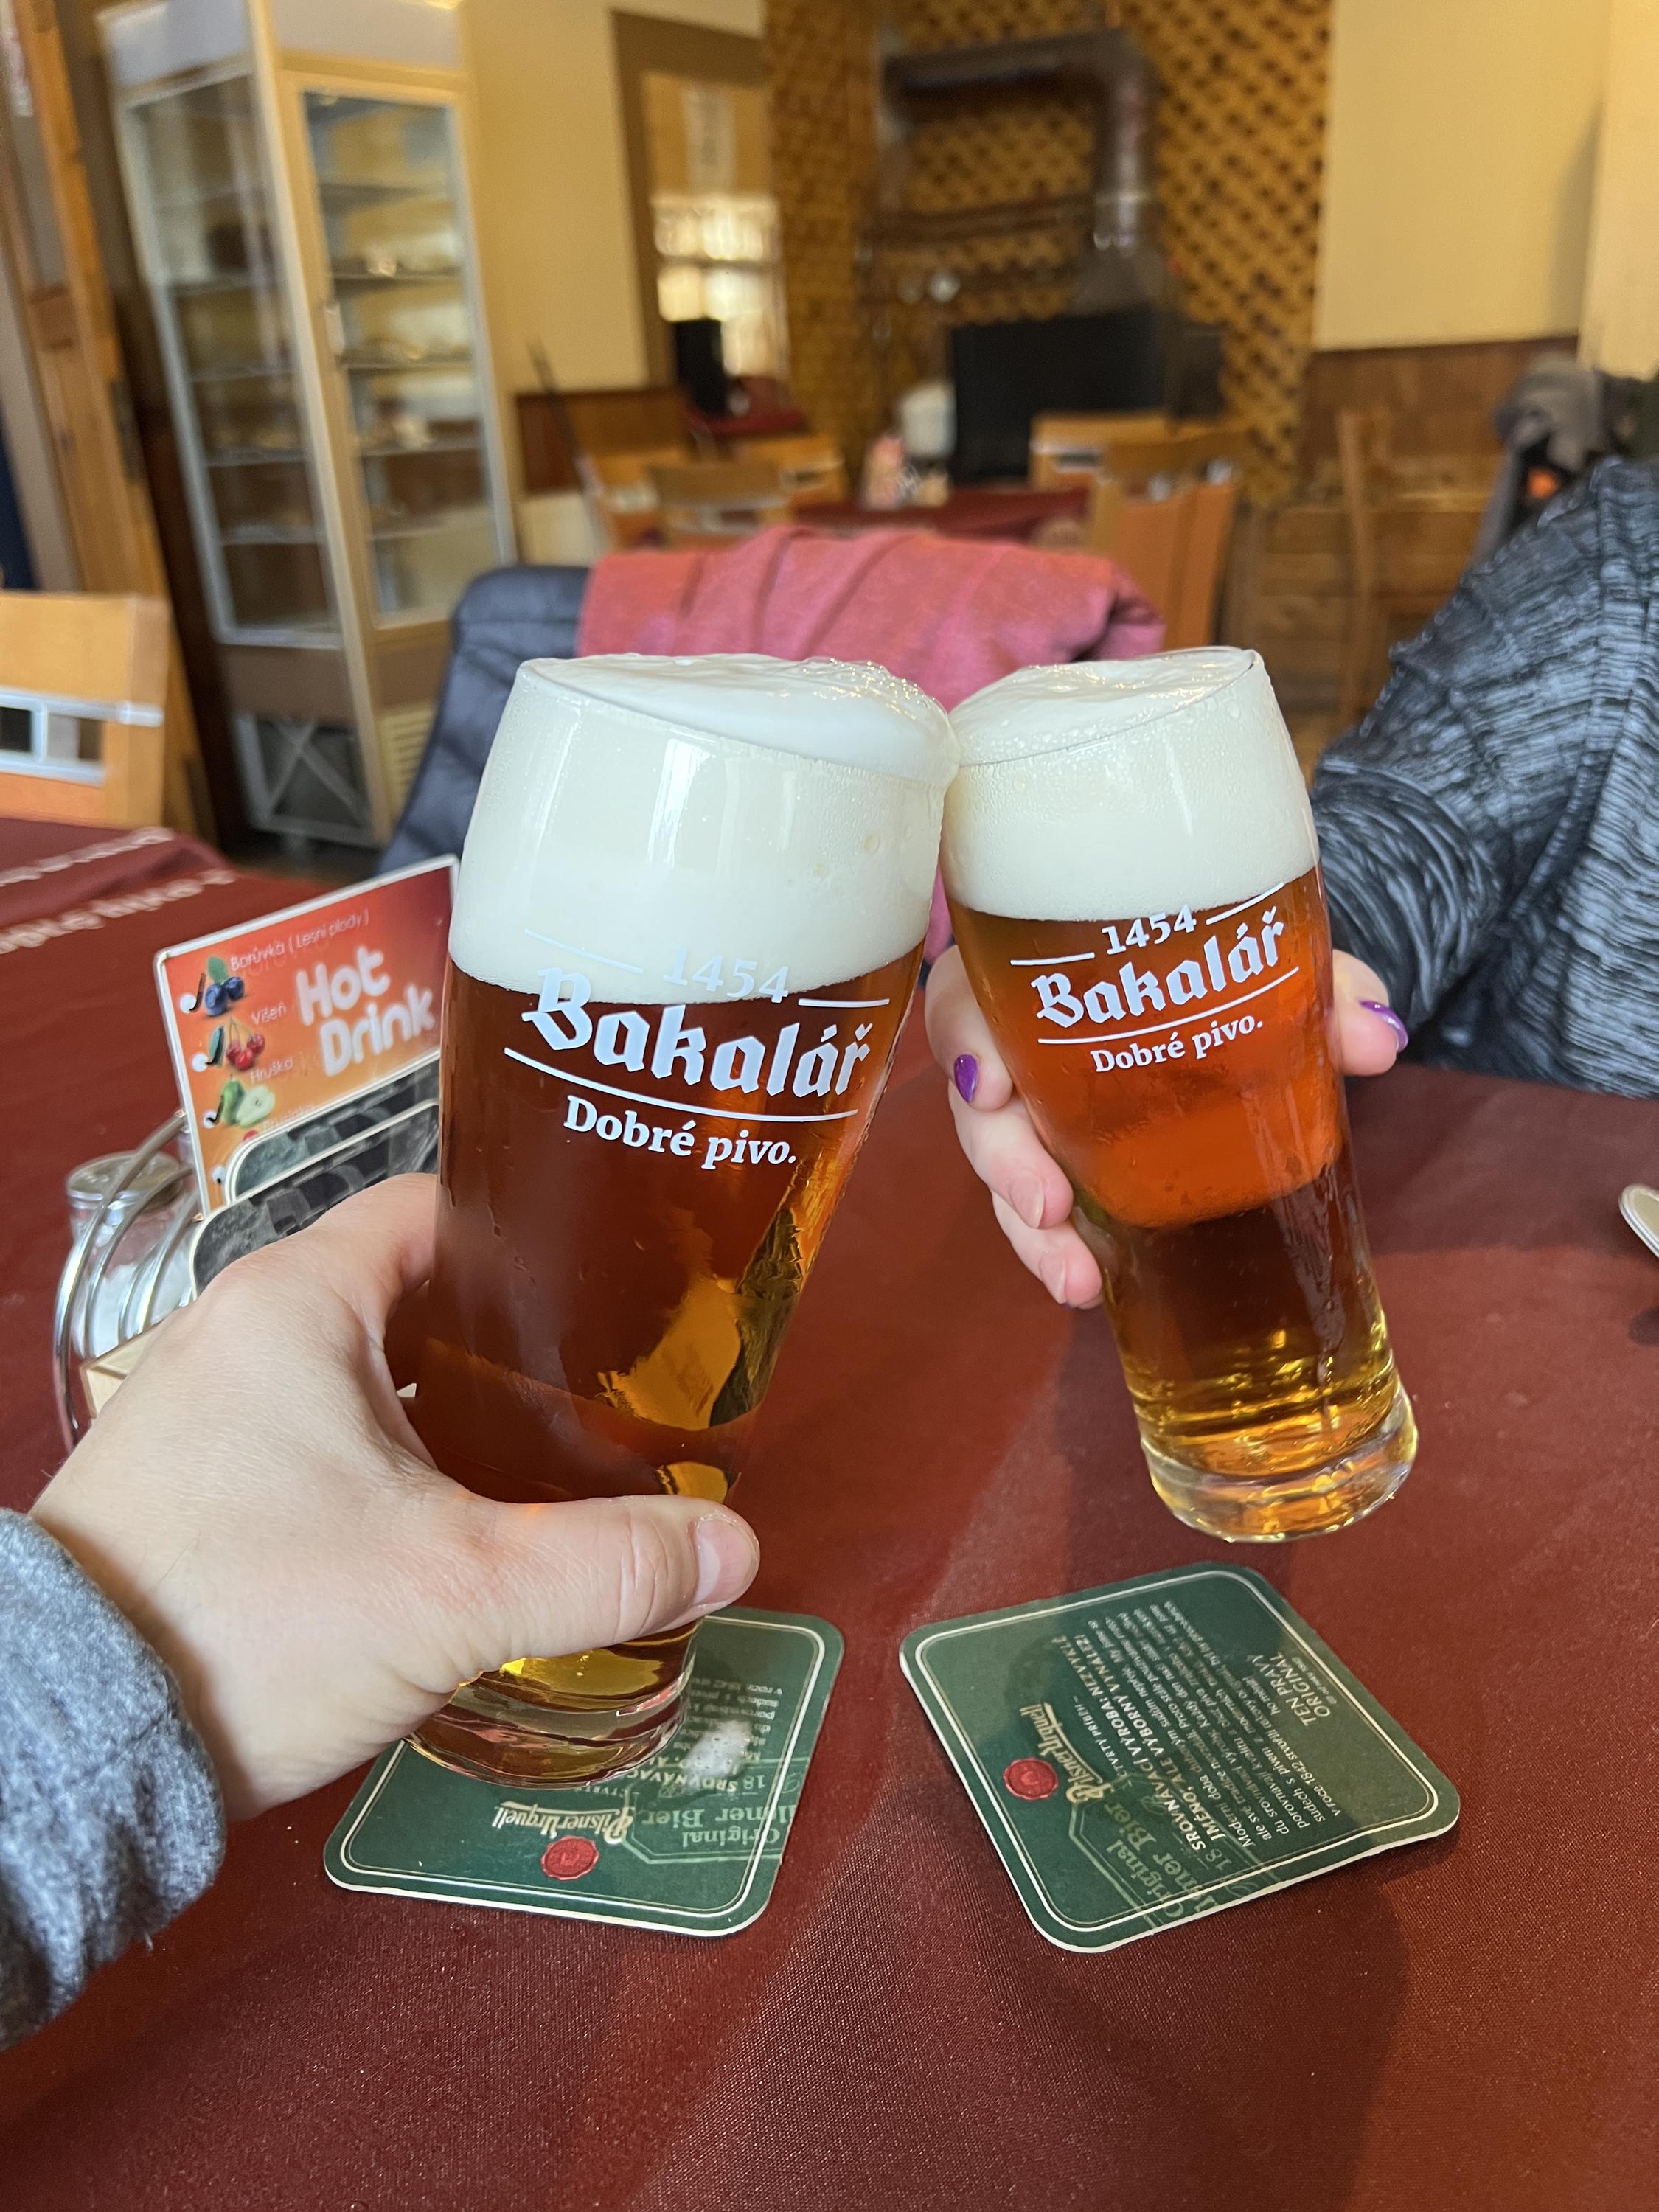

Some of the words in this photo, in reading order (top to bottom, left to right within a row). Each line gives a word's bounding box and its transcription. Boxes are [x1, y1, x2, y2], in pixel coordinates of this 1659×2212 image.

[1102, 905, 1196, 955] 1454
[296, 945, 390, 1026] Hot
[664, 947, 789, 1004] 1454
[1031, 906, 1284, 1028] Bakalář
[319, 984, 435, 1077] Drink
[521, 967, 873, 1097] Bakalář
[1090, 1032, 1185, 1072] Dobré
[1192, 1014, 1263, 1060] pivo.
[563, 1095, 697, 1156] Dobré
[701, 1130, 796, 1170] pivo.
[1018, 1703, 1063, 1756] Urquell
[1093, 1697, 1144, 1756] VÝROBA:
[1111, 1692, 1167, 1757] VÝBORNÝ
[1164, 1703, 1192, 1728] Proto
[1284, 1697, 1319, 1727] TEN
[1051, 1747, 1113, 1805] Pilsner
[1157, 1757, 1186, 1784] ALE
[1258, 1745, 1291, 1775] pivem
[1290, 1760, 1317, 1784] 1842
[1133, 1757, 1207, 1851] SROVNÁVACÍ
[1195, 1774, 1222, 1801] doba
[1290, 1787, 1326, 1823] sudech
[1312, 1784, 1336, 1808] roce
[490, 1803, 560, 1839] Urquell
[555, 1805, 636, 1844] Pilsner
[641, 1809, 704, 1828] Bier
[682, 1825, 780, 1847] Original
[1102, 1802, 1156, 1850] Bier
[1175, 1785, 1227, 1841] JMÉNO,
[1252, 1823, 1273, 1841] ale
[1271, 1820, 1290, 1835] du
[1105, 1838, 1184, 1917] Original
